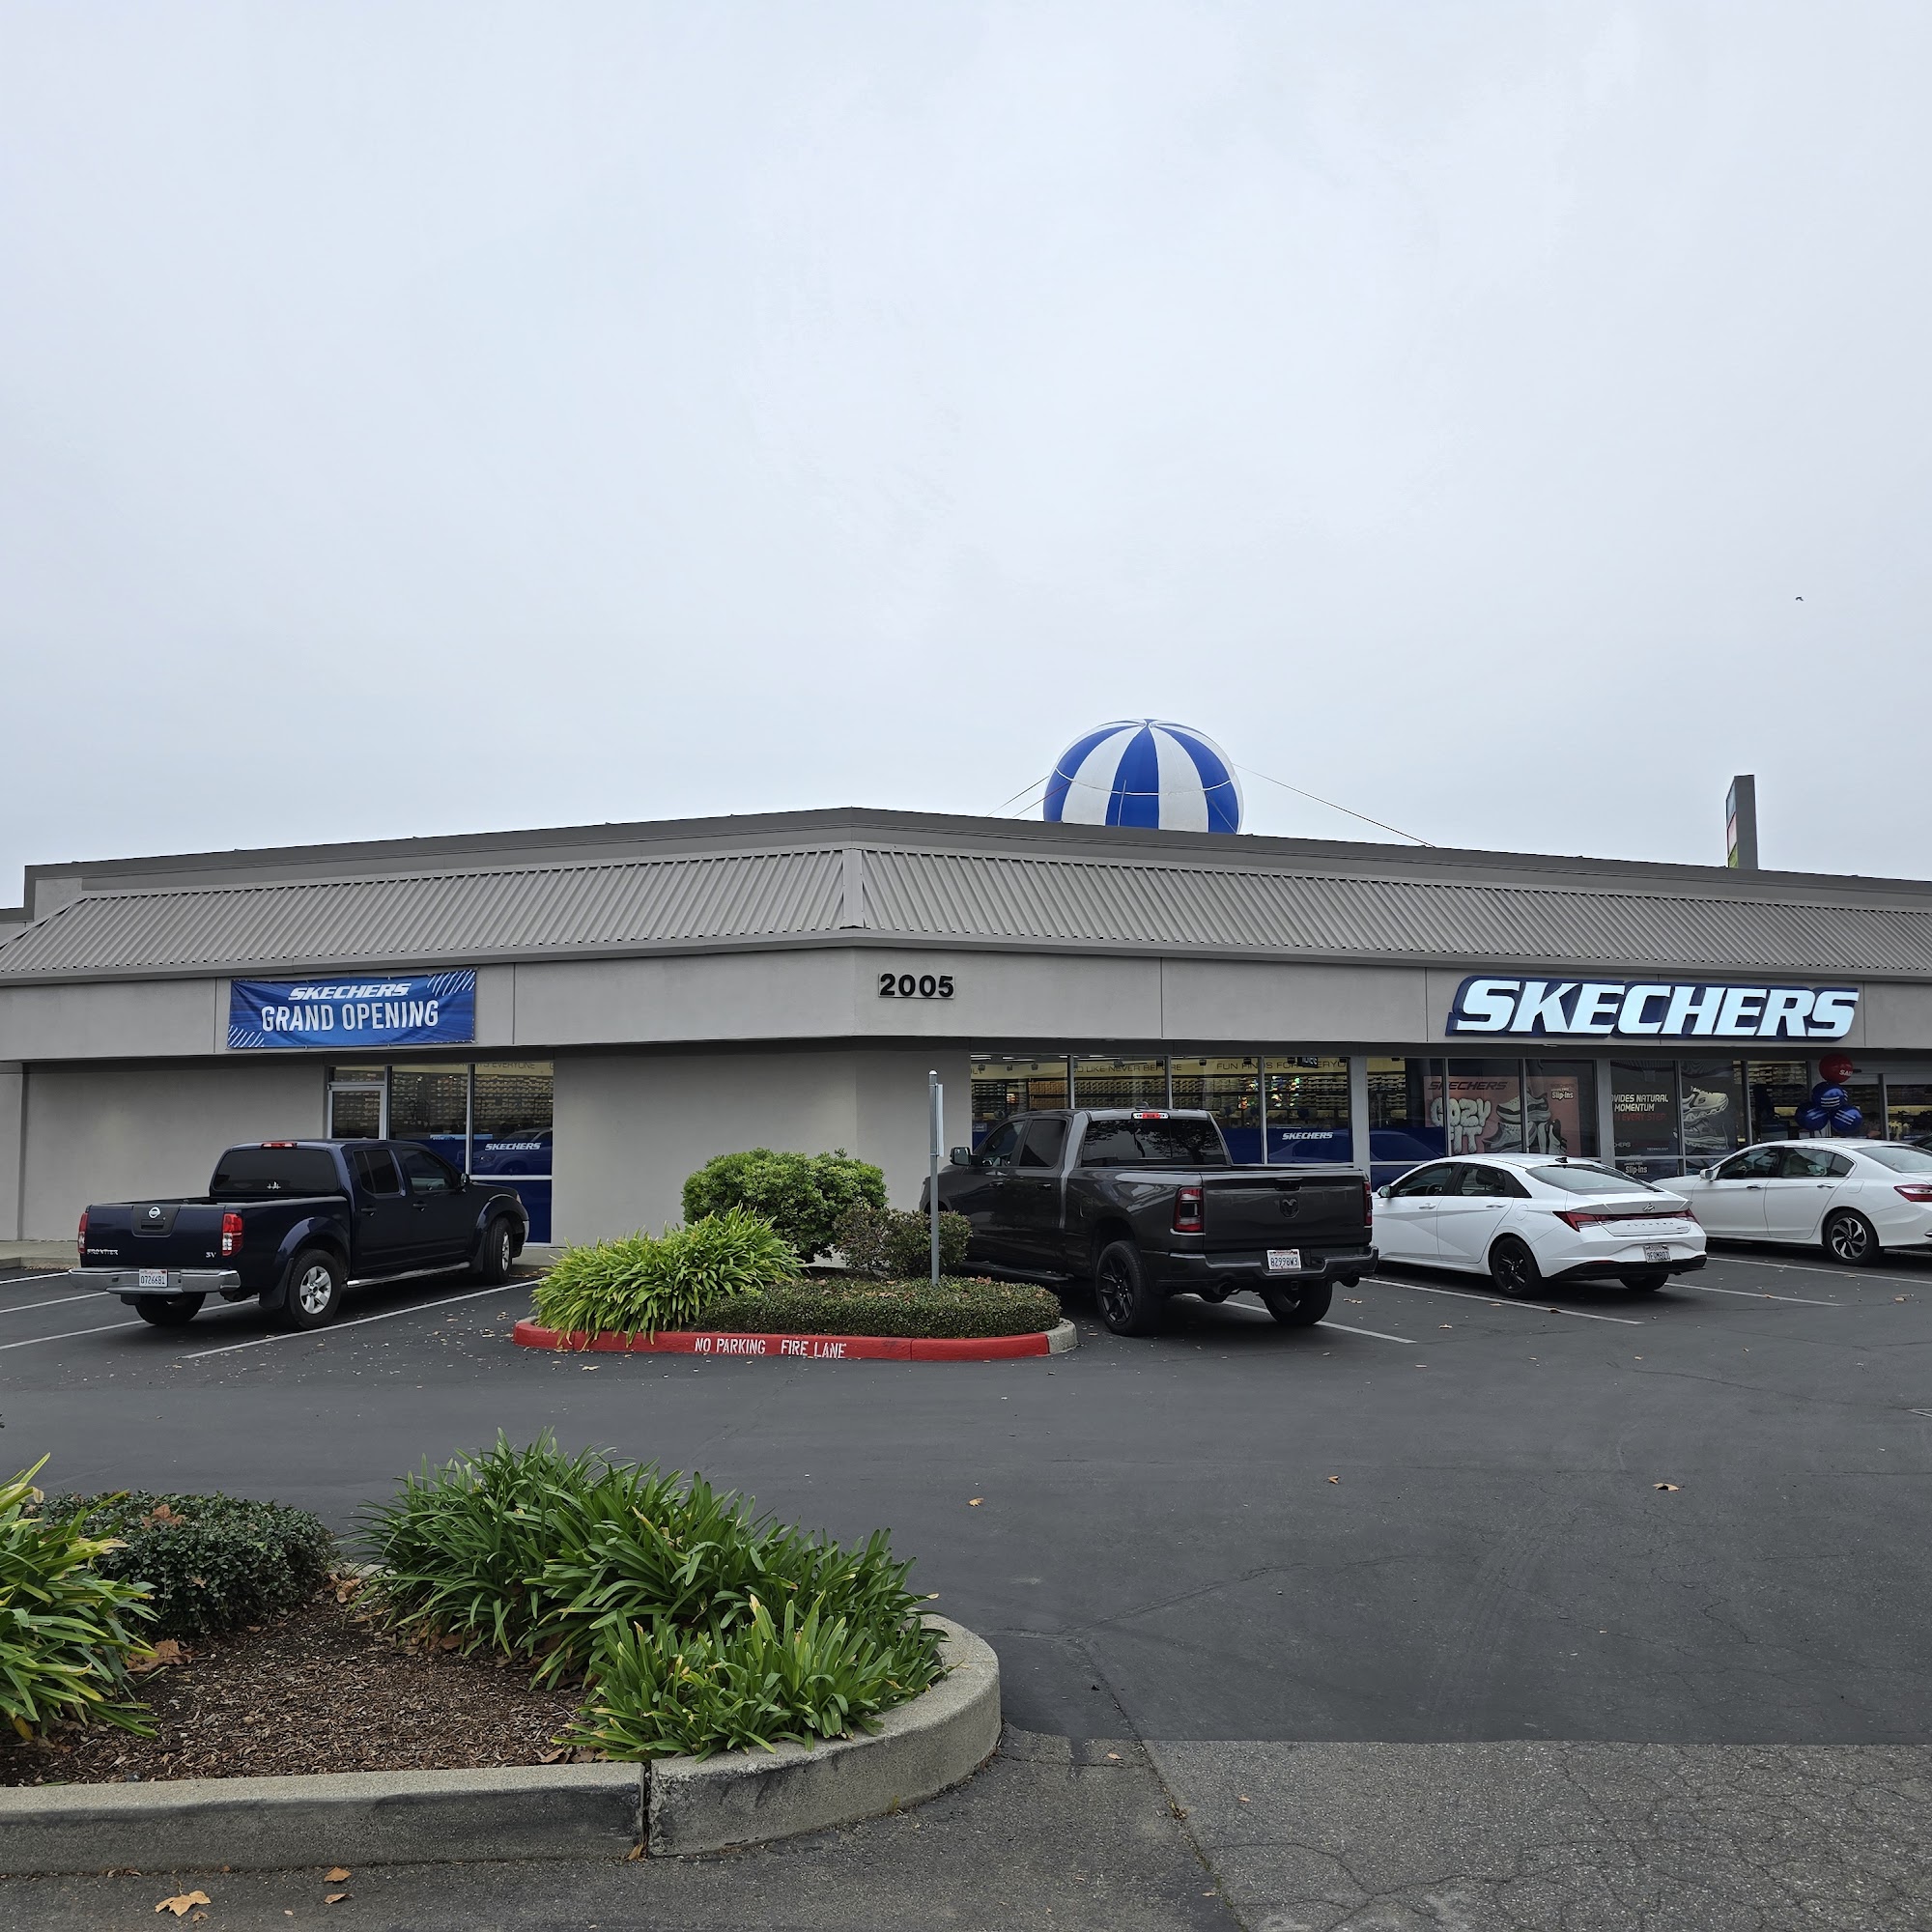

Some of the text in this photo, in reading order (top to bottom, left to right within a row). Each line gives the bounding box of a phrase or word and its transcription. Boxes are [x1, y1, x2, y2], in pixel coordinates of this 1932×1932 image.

[288, 982, 412, 1001] SKECHERS
[880, 973, 953, 997] 2005
[261, 1000, 439, 1032] GRAND OPENING
[1453, 980, 1860, 1037] SKECHERS
[1611, 1094, 1669, 1103] VIDES NATURAL
[1614, 1103, 1655, 1112] MOMENTUM
[1282, 1131, 1334, 1141] SKECHERS
[484, 1142, 541, 1151] SKECHERS
[695, 1338, 847, 1359] NO PARKING FIRE LANE
